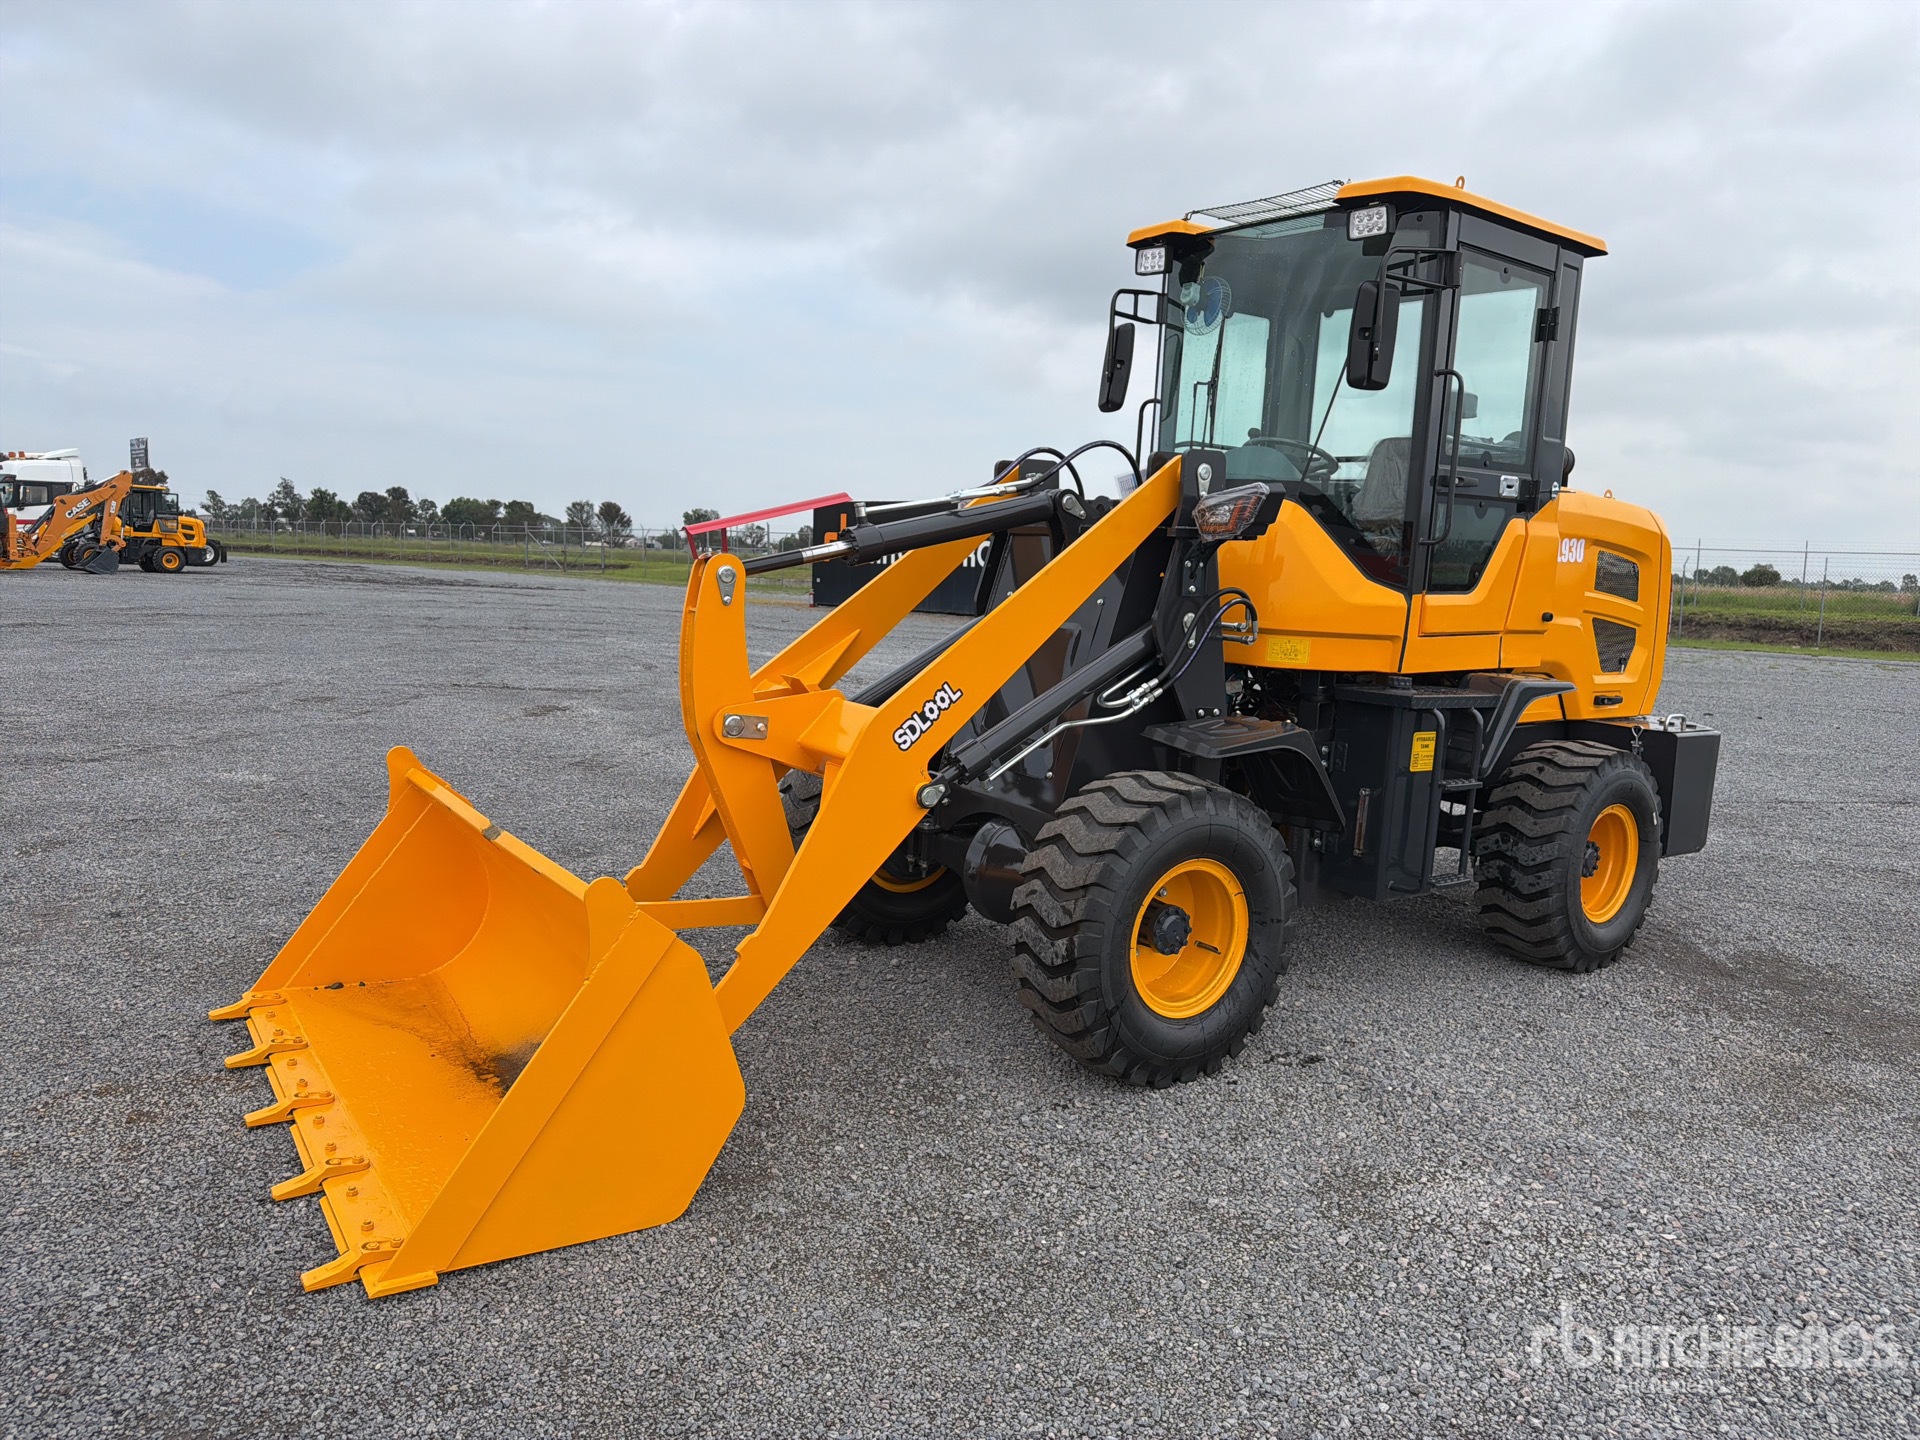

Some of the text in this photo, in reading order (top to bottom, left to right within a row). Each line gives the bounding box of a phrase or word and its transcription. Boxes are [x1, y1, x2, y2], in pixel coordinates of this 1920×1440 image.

[65, 497, 91, 518] CASE
[1557, 537, 1585, 563] L930
[893, 682, 962, 751] SDLOOL
